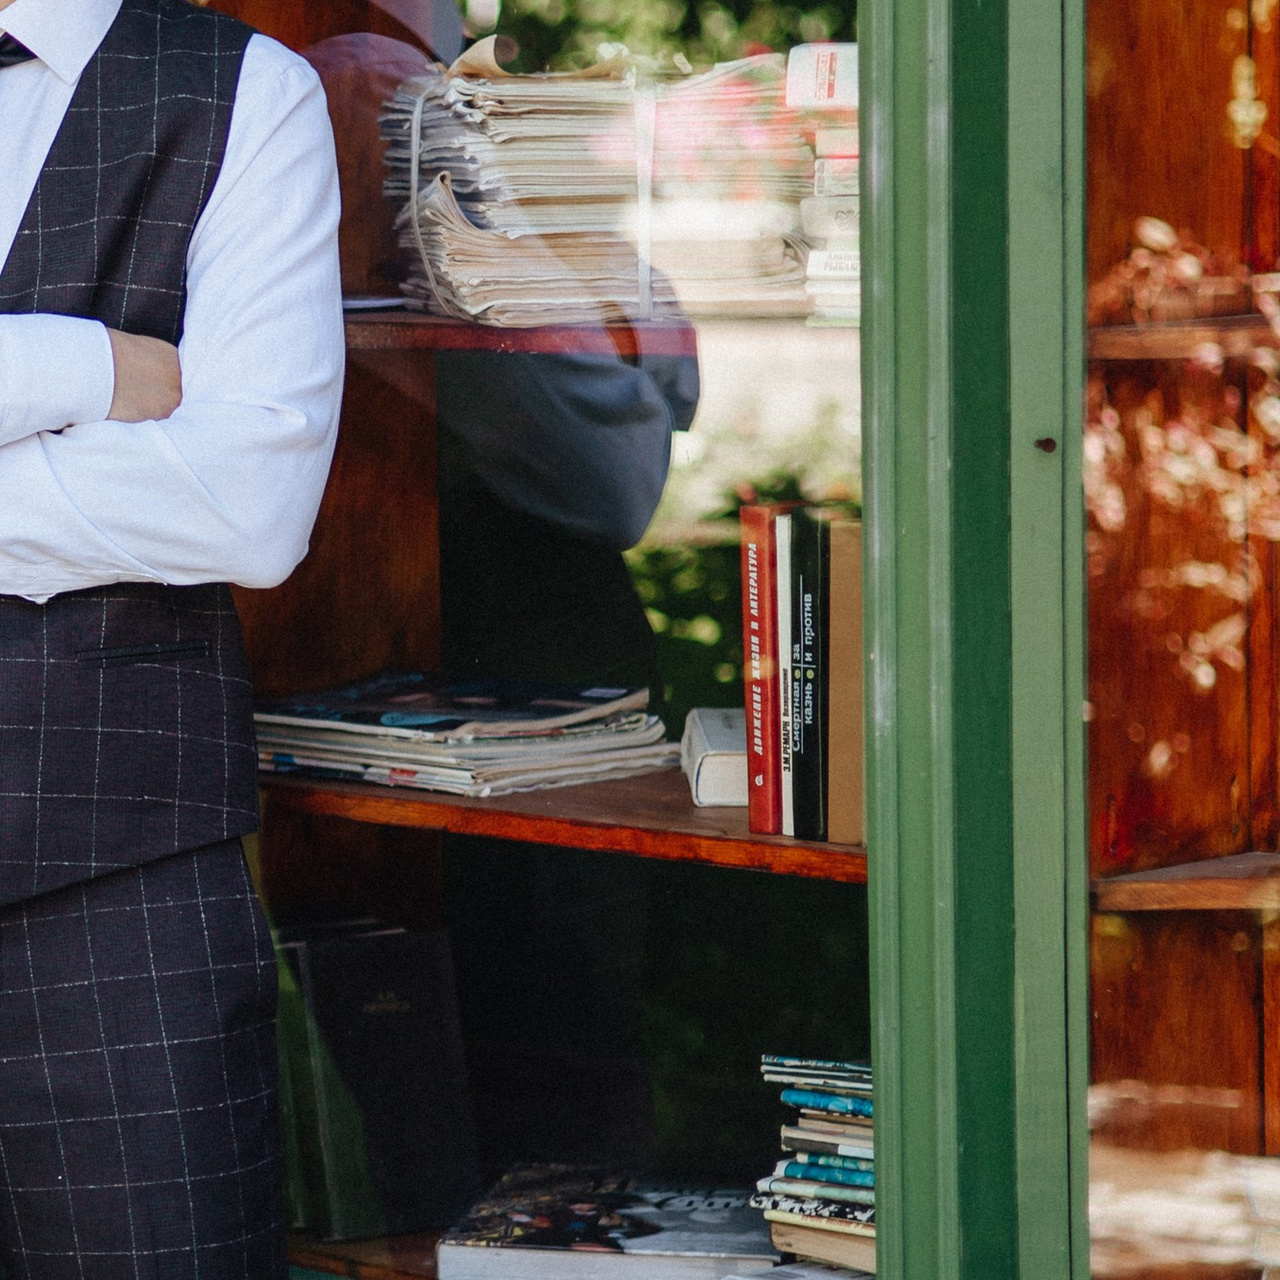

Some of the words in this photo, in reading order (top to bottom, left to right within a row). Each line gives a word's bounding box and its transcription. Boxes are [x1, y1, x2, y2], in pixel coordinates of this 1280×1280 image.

[748, 543, 759, 617] ЛИТЕРАТУРА
[750, 621, 759, 631] И
[804, 593, 815, 645] против
[750, 635, 761, 680] ЖИЗНИ
[792, 643, 800, 660] за
[804, 652, 813, 662] и
[752, 685, 763, 756] ДВИЖЕНИЕ
[792, 681, 801, 752] Смертная
[804, 682, 813, 724] казнь
